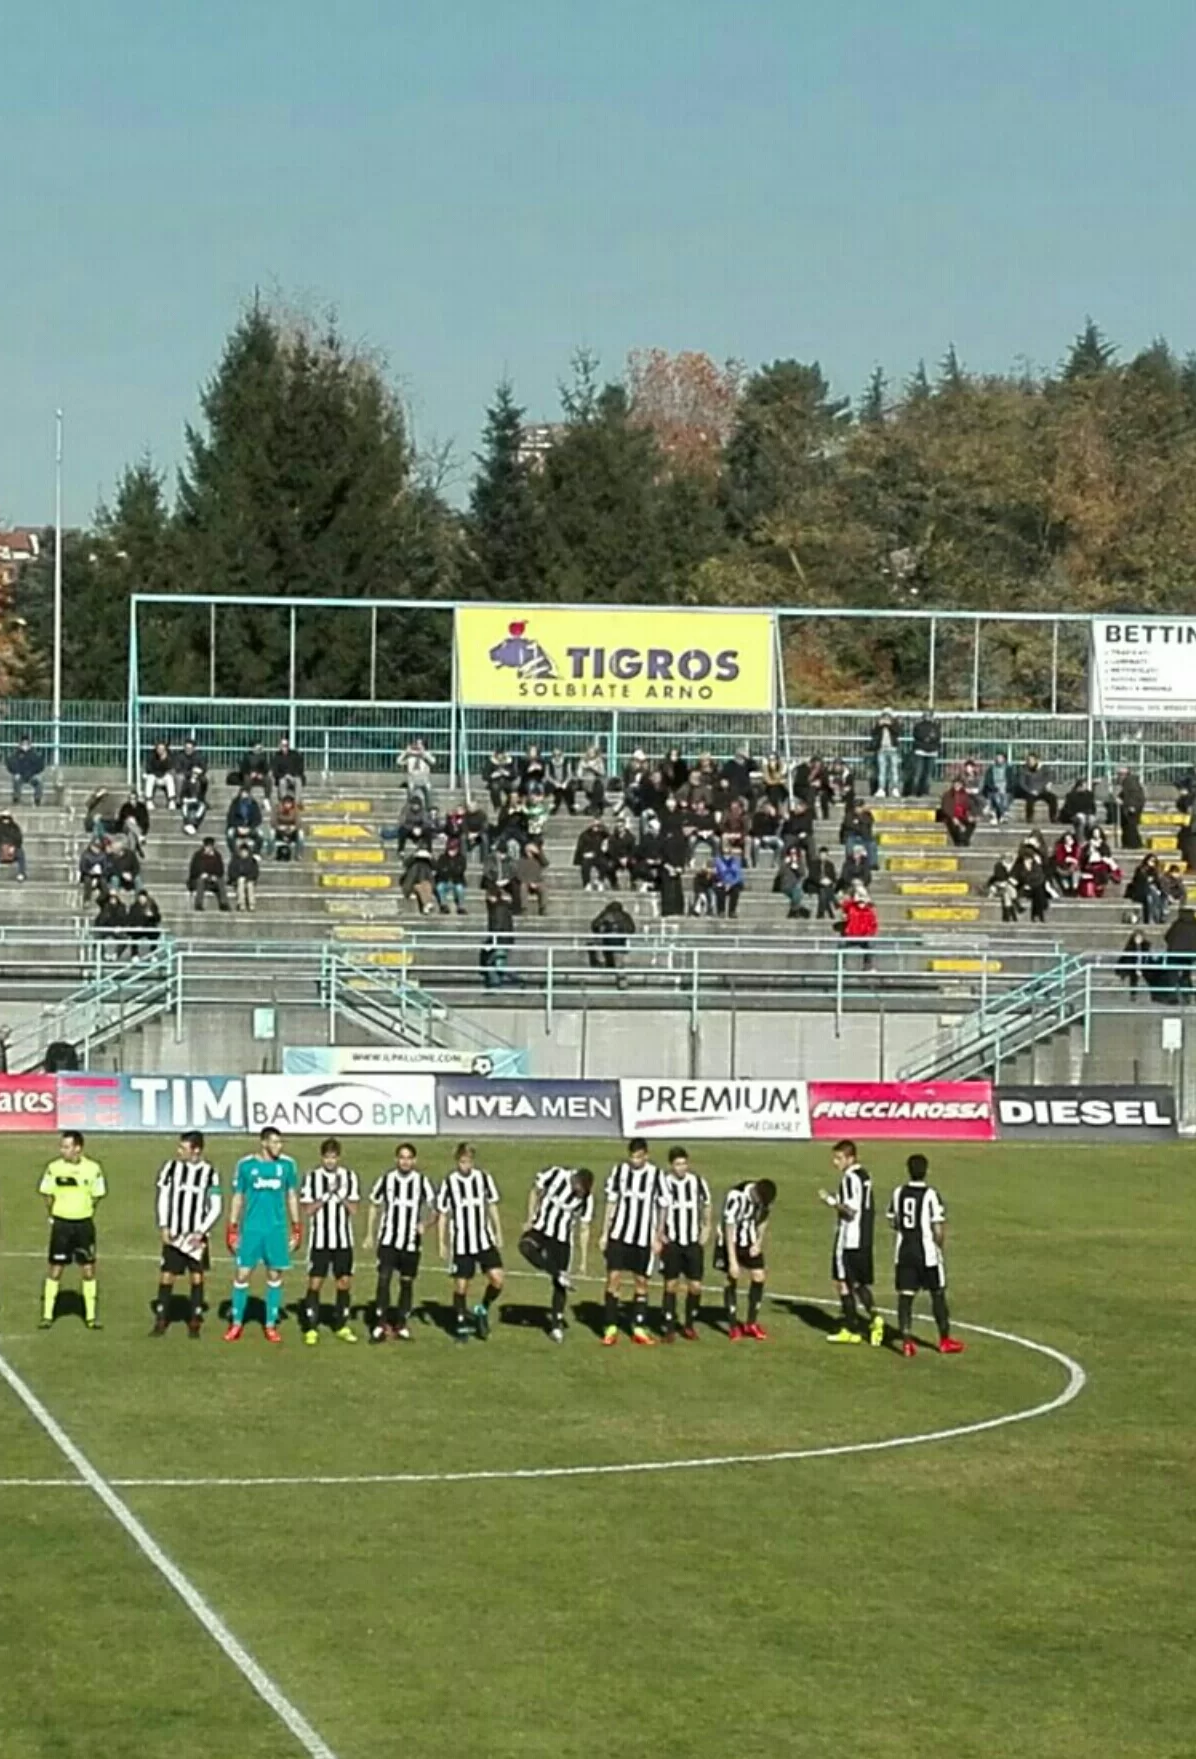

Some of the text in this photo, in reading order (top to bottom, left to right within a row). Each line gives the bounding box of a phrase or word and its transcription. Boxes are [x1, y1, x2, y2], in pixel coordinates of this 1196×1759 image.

[567, 648, 740, 681] TIGROS
[519, 682, 713, 700] SOLBIATE ARNO
[130, 1078, 243, 1127] TIM
[446, 1093, 611, 1119] NIVEA MEN
[636, 1086, 799, 1114] PREMIUM
[812, 1101, 991, 1119] FRECCIAROSSA
[999, 1100, 1172, 1126] DIESEL
[253, 1101, 431, 1126] BANCO BPM
[903, 1197, 917, 1229] 9
